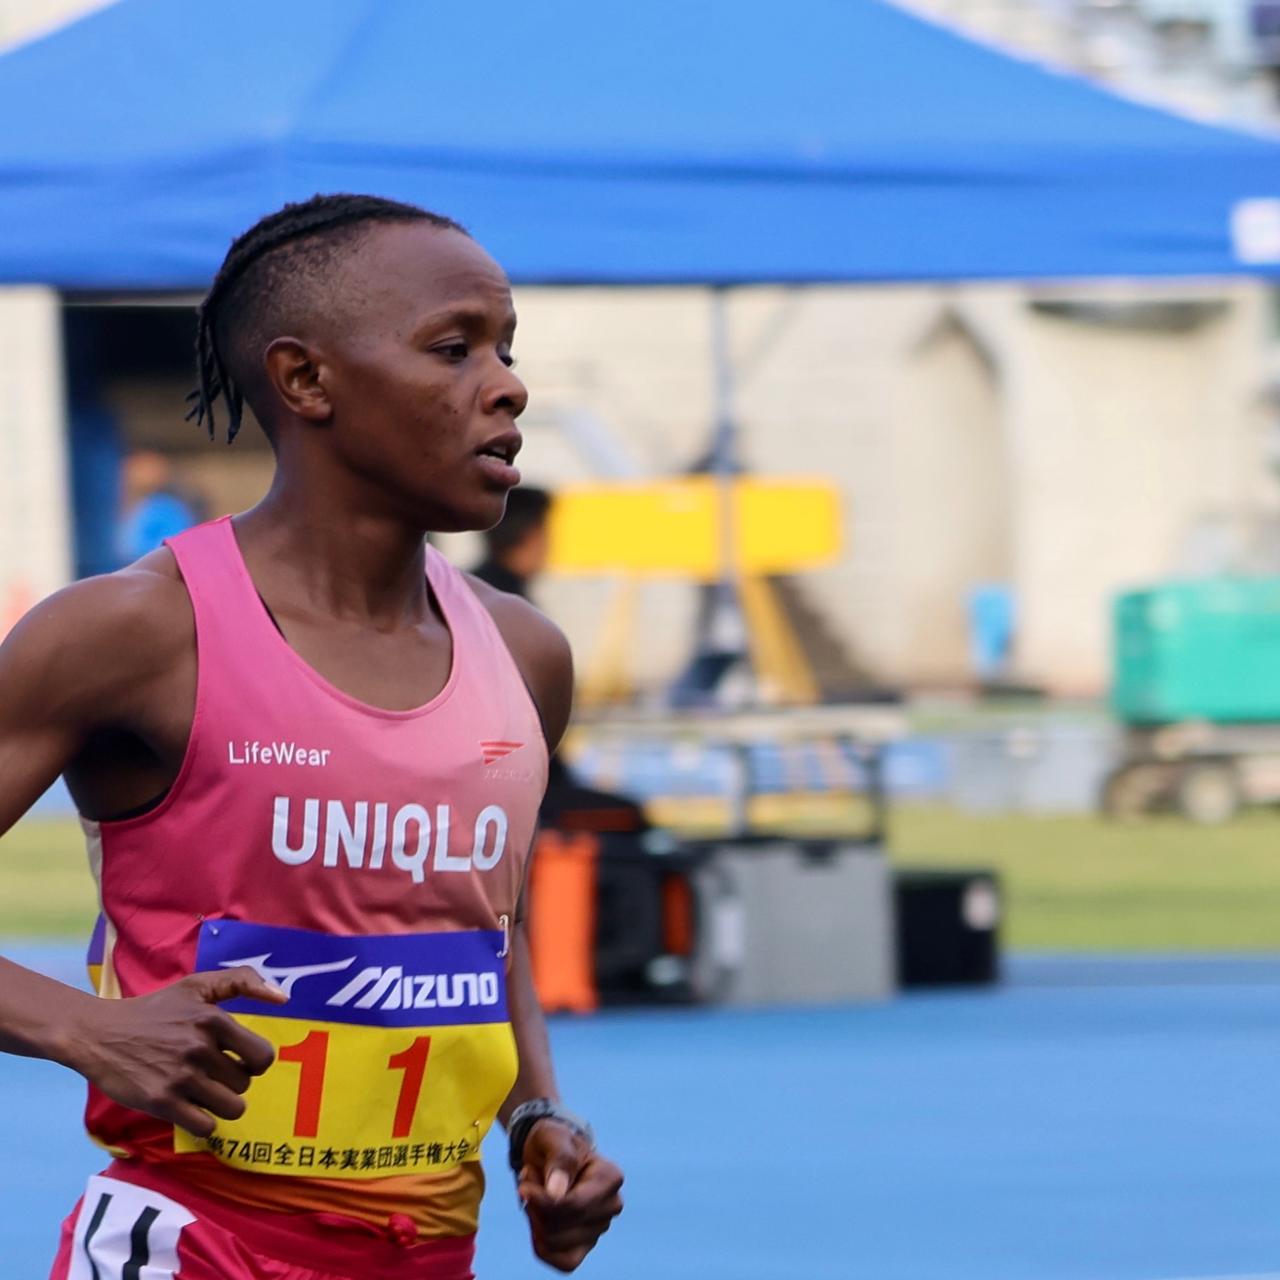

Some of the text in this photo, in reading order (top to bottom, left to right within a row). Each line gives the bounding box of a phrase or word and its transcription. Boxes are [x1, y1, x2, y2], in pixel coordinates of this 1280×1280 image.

[228, 741, 330, 766] LifeWear
[271, 796, 508, 883] UNIQLO
[278, 1031, 430, 1138] 11
